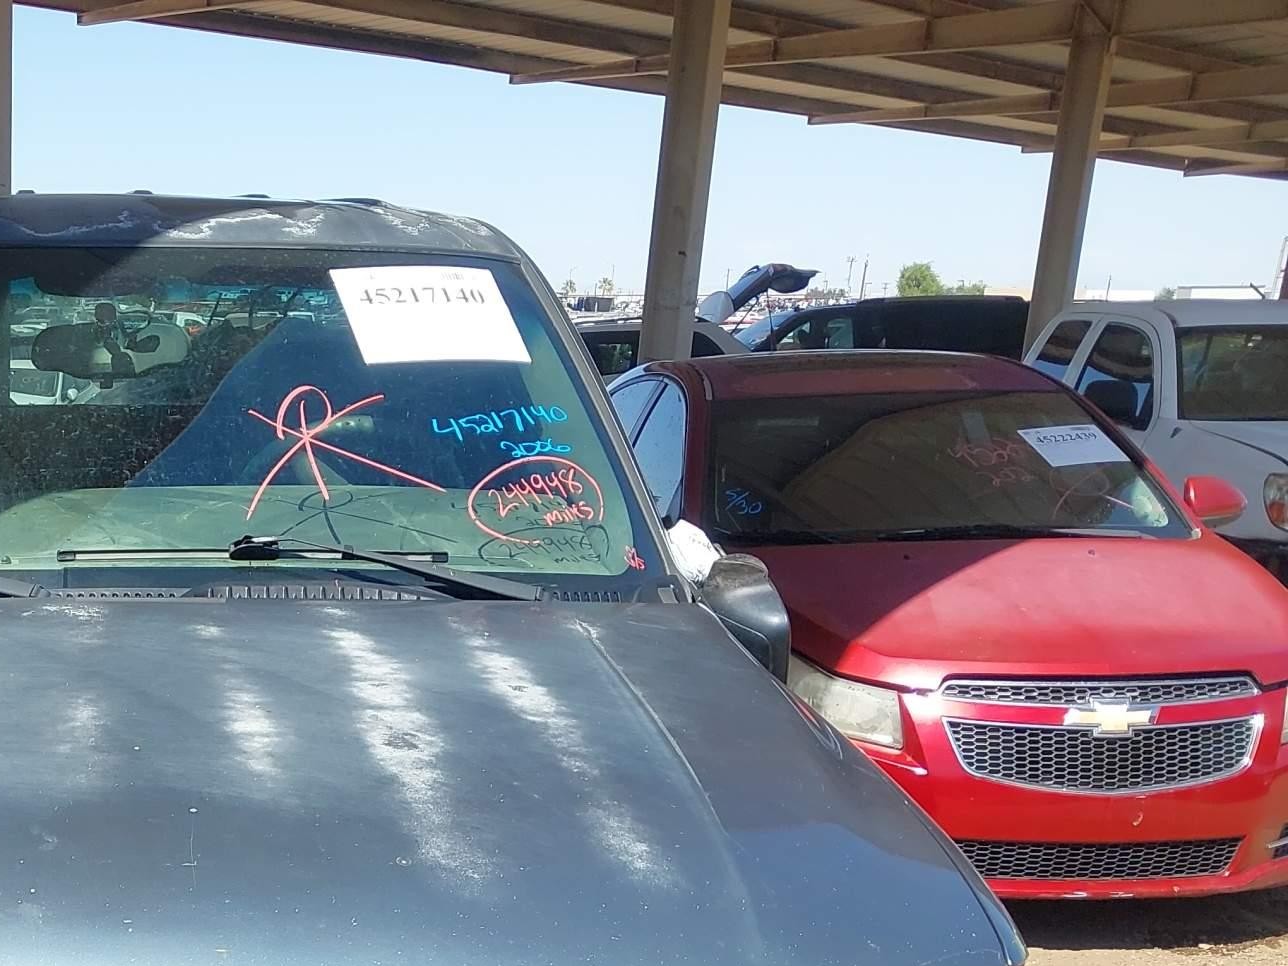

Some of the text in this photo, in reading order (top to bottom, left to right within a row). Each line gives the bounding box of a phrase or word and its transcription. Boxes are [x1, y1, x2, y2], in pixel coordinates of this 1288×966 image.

[359, 286, 486, 305] 45217140
[431, 404, 569, 441] 45217140
[500, 438, 572, 458] 2006
[1035, 431, 1098, 446] 45222439
[487, 467, 584, 518] 244948
[724, 488, 763, 515] 5/30
